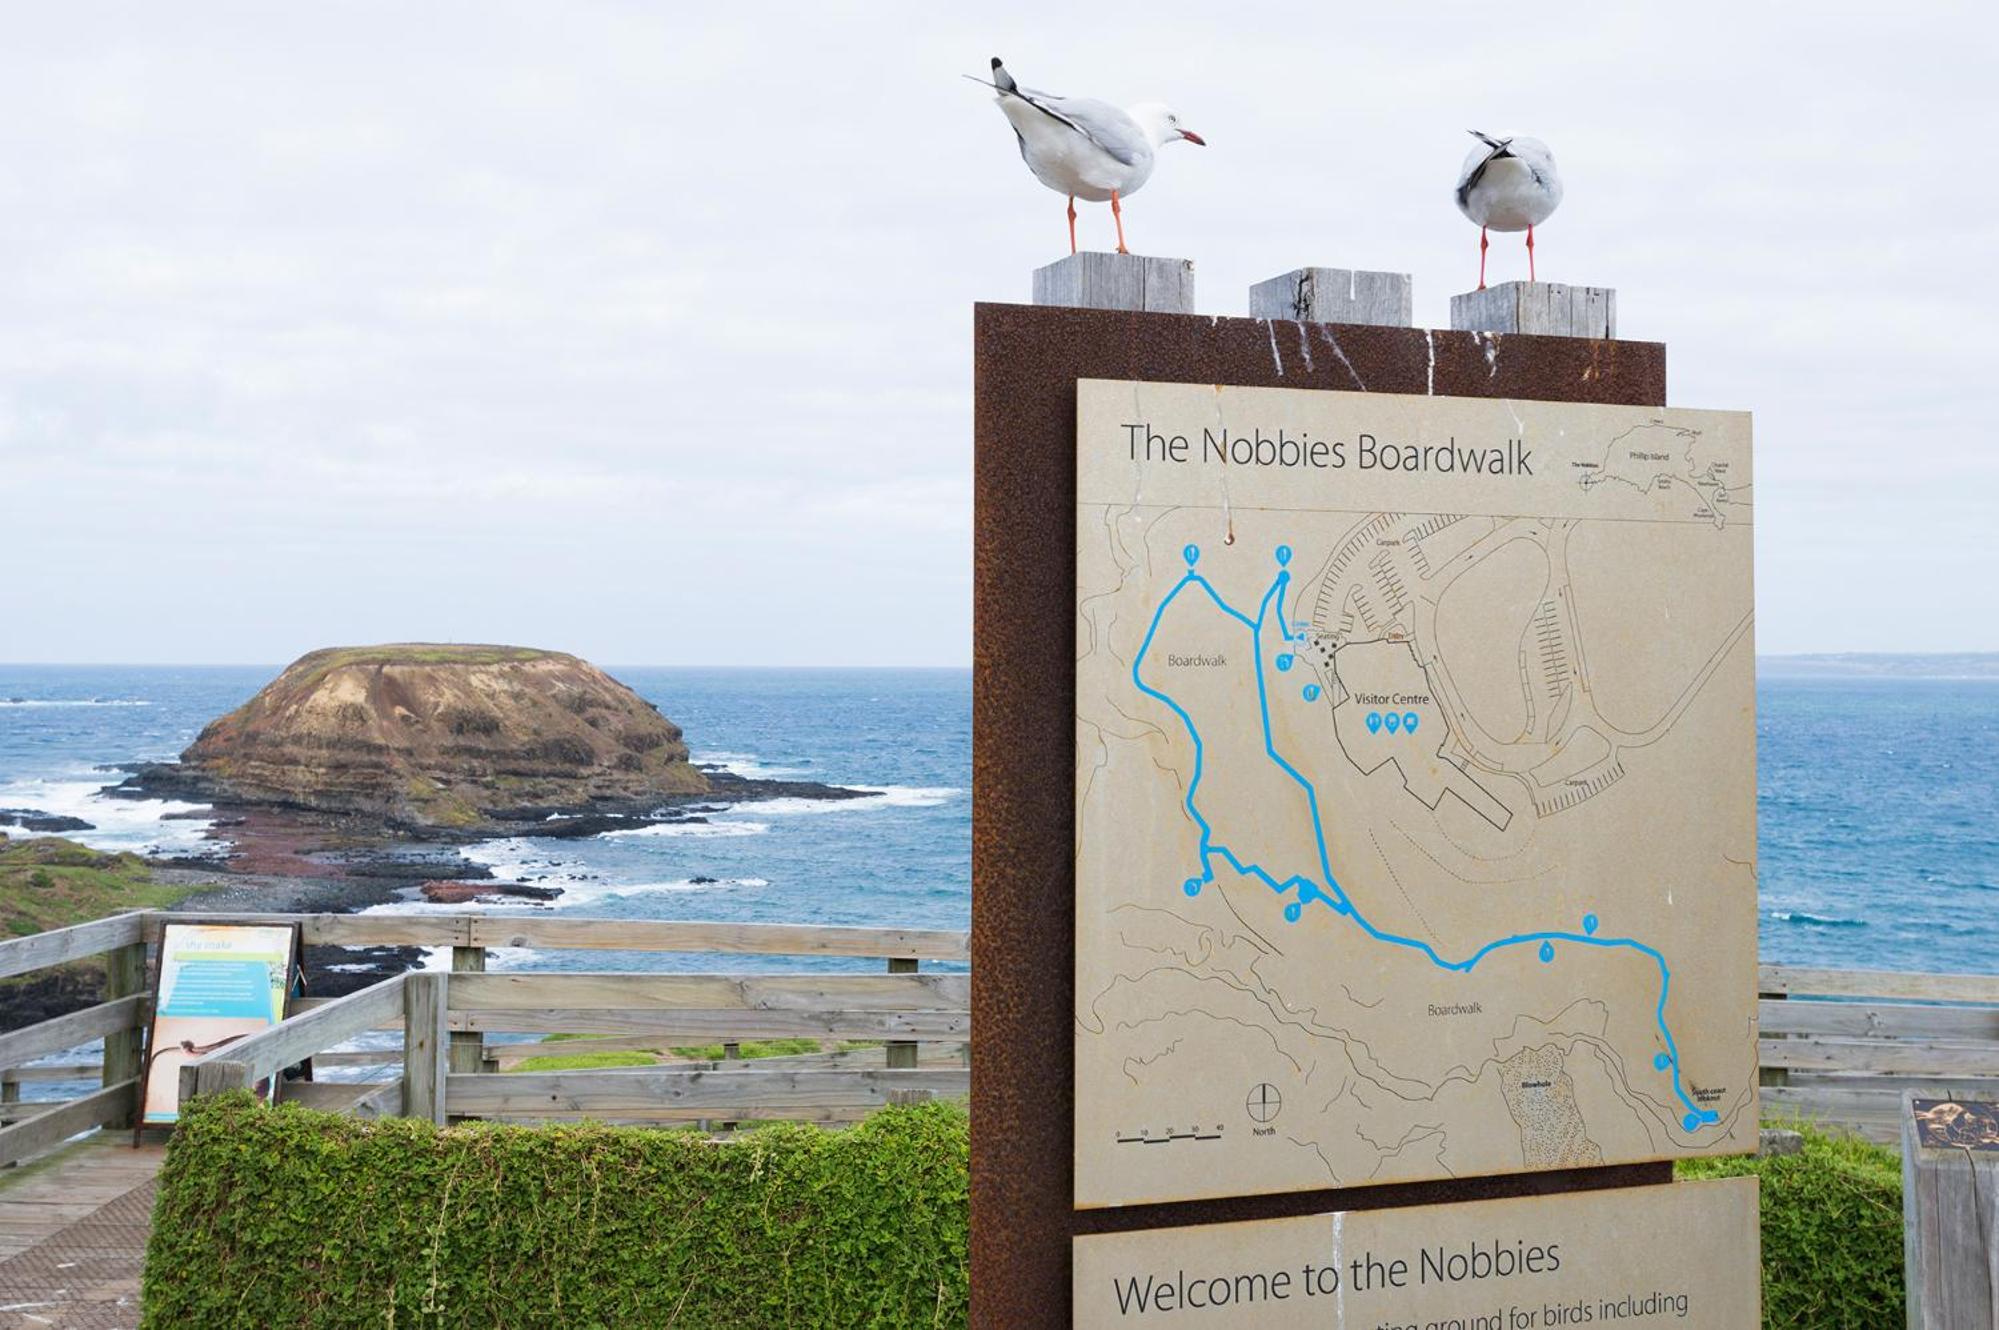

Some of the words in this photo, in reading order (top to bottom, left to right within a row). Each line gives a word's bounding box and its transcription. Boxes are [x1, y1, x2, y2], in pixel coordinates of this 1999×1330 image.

[1121, 423, 1188, 462] The
[1204, 427, 1346, 469] Nobbies
[1358, 433, 1534, 476] Boardwalk
[1168, 654, 1228, 667] Boardwalk
[1354, 692, 1390, 705] Visitor
[1391, 692, 1430, 705] Centre
[1428, 1001, 1483, 1016] Boardwalk
[1252, 1127, 1276, 1137] North
[1113, 1269, 1291, 1316] Welcome
[1301, 1263, 1339, 1297] to
[1350, 1251, 1408, 1291] the
[1420, 1239, 1560, 1285] Nobbies
[1509, 1306, 1537, 1330] for
[1544, 1300, 1593, 1327] birds
[1599, 1291, 1688, 1318] including
